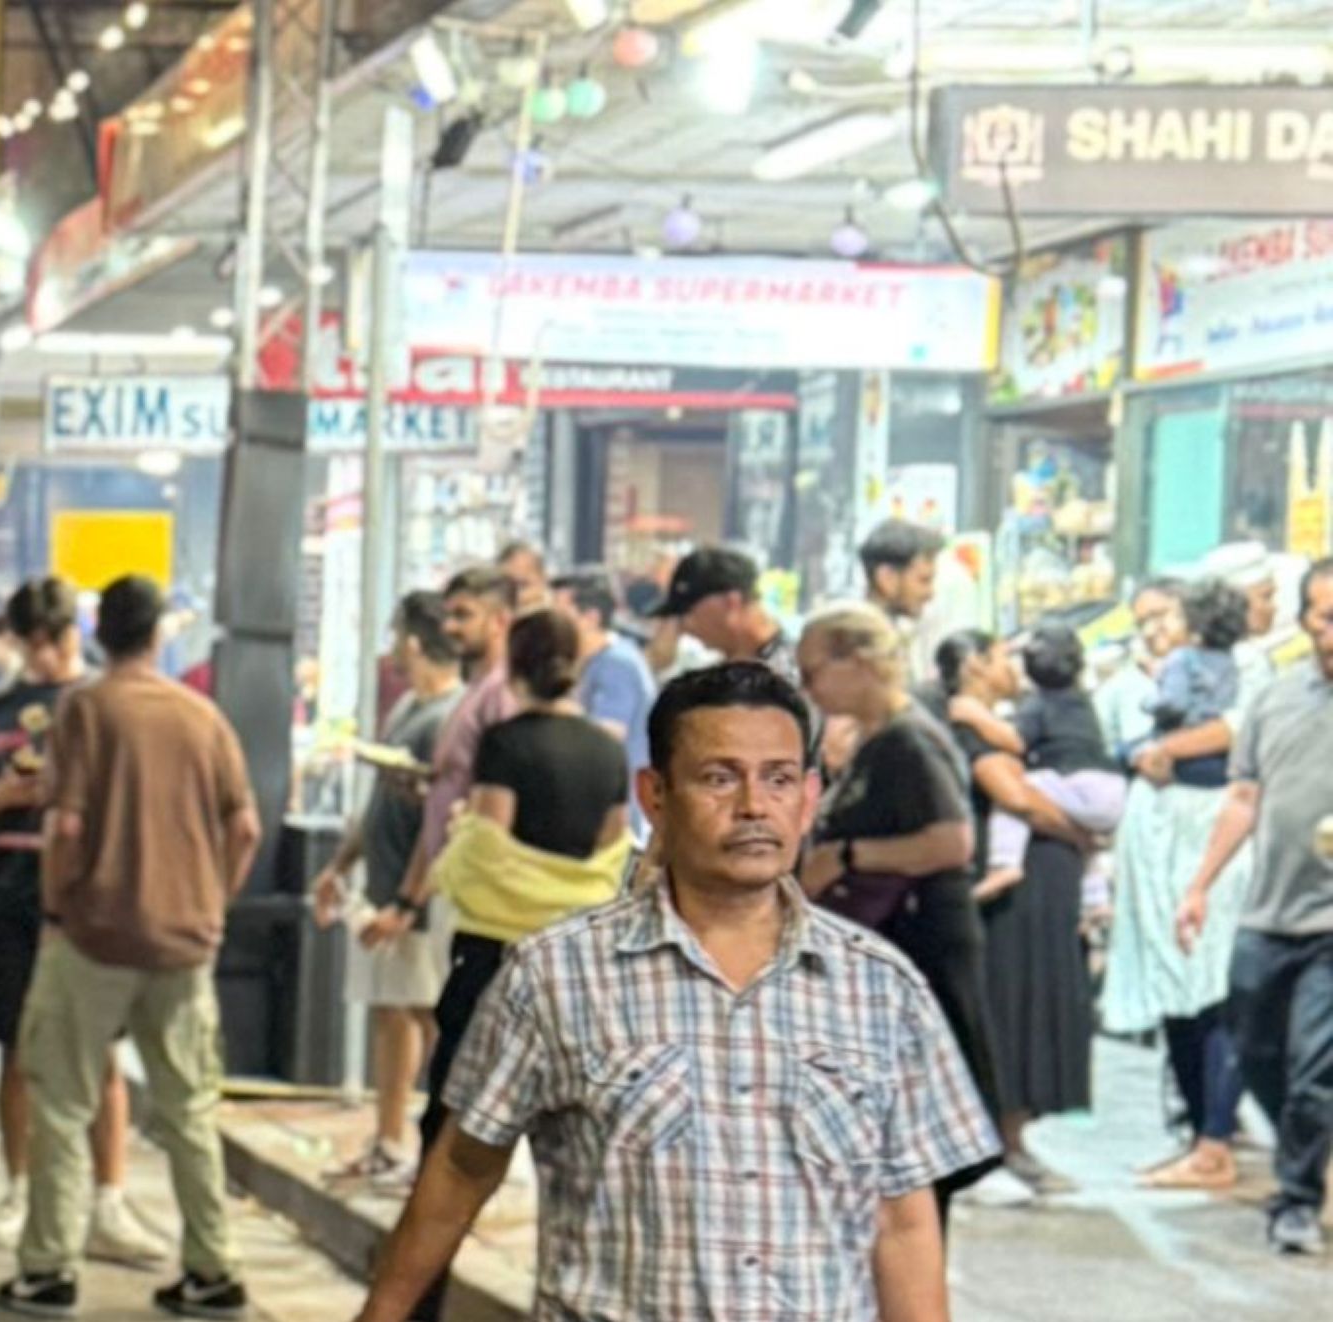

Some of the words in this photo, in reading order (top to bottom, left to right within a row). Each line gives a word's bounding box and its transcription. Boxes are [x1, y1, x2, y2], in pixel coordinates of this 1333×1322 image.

[1067, 107, 1251, 160] SHAHI
[653, 276, 909, 308] SUPERMARKET
[52, 386, 171, 440] EXIM
